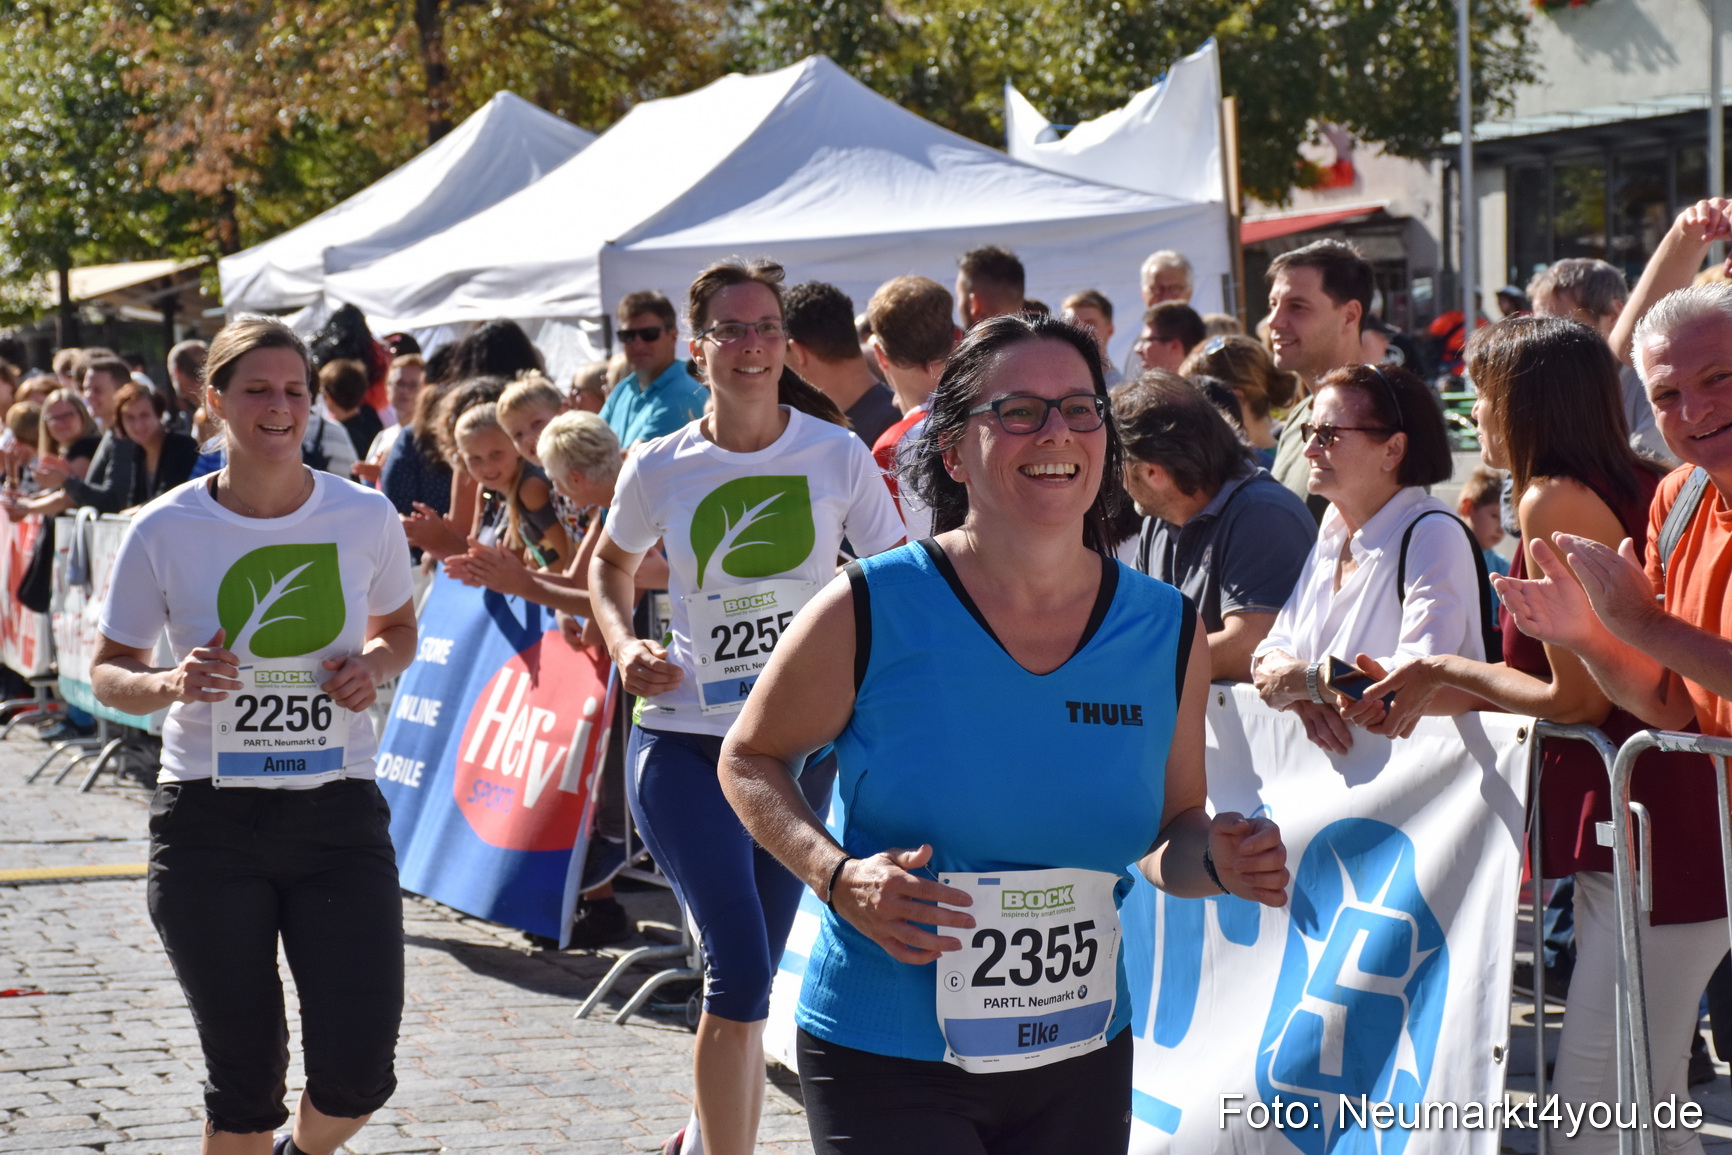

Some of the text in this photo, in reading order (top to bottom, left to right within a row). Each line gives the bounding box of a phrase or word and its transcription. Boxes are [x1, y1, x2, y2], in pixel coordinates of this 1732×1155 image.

[723, 590, 777, 613] BOCK
[255, 671, 316, 684] BOCK
[724, 663, 751, 675] PARTL
[235, 694, 332, 732] 2256
[1065, 701, 1142, 726] THULE
[243, 738, 315, 747] PARTL Neumarkt
[263, 756, 306, 773] Anna
[376, 752, 426, 788] OBILE
[1002, 884, 1075, 910] BOCK
[1001, 911, 1029, 919] inspired
[1030, 911, 1040, 919] by
[1041, 909, 1056, 917] smart
[971, 920, 1098, 987] 2355
[950, 976, 958, 987] C
[984, 990, 1075, 1009] PARTL Neumarkt
[1018, 1022, 1059, 1048] Elke
